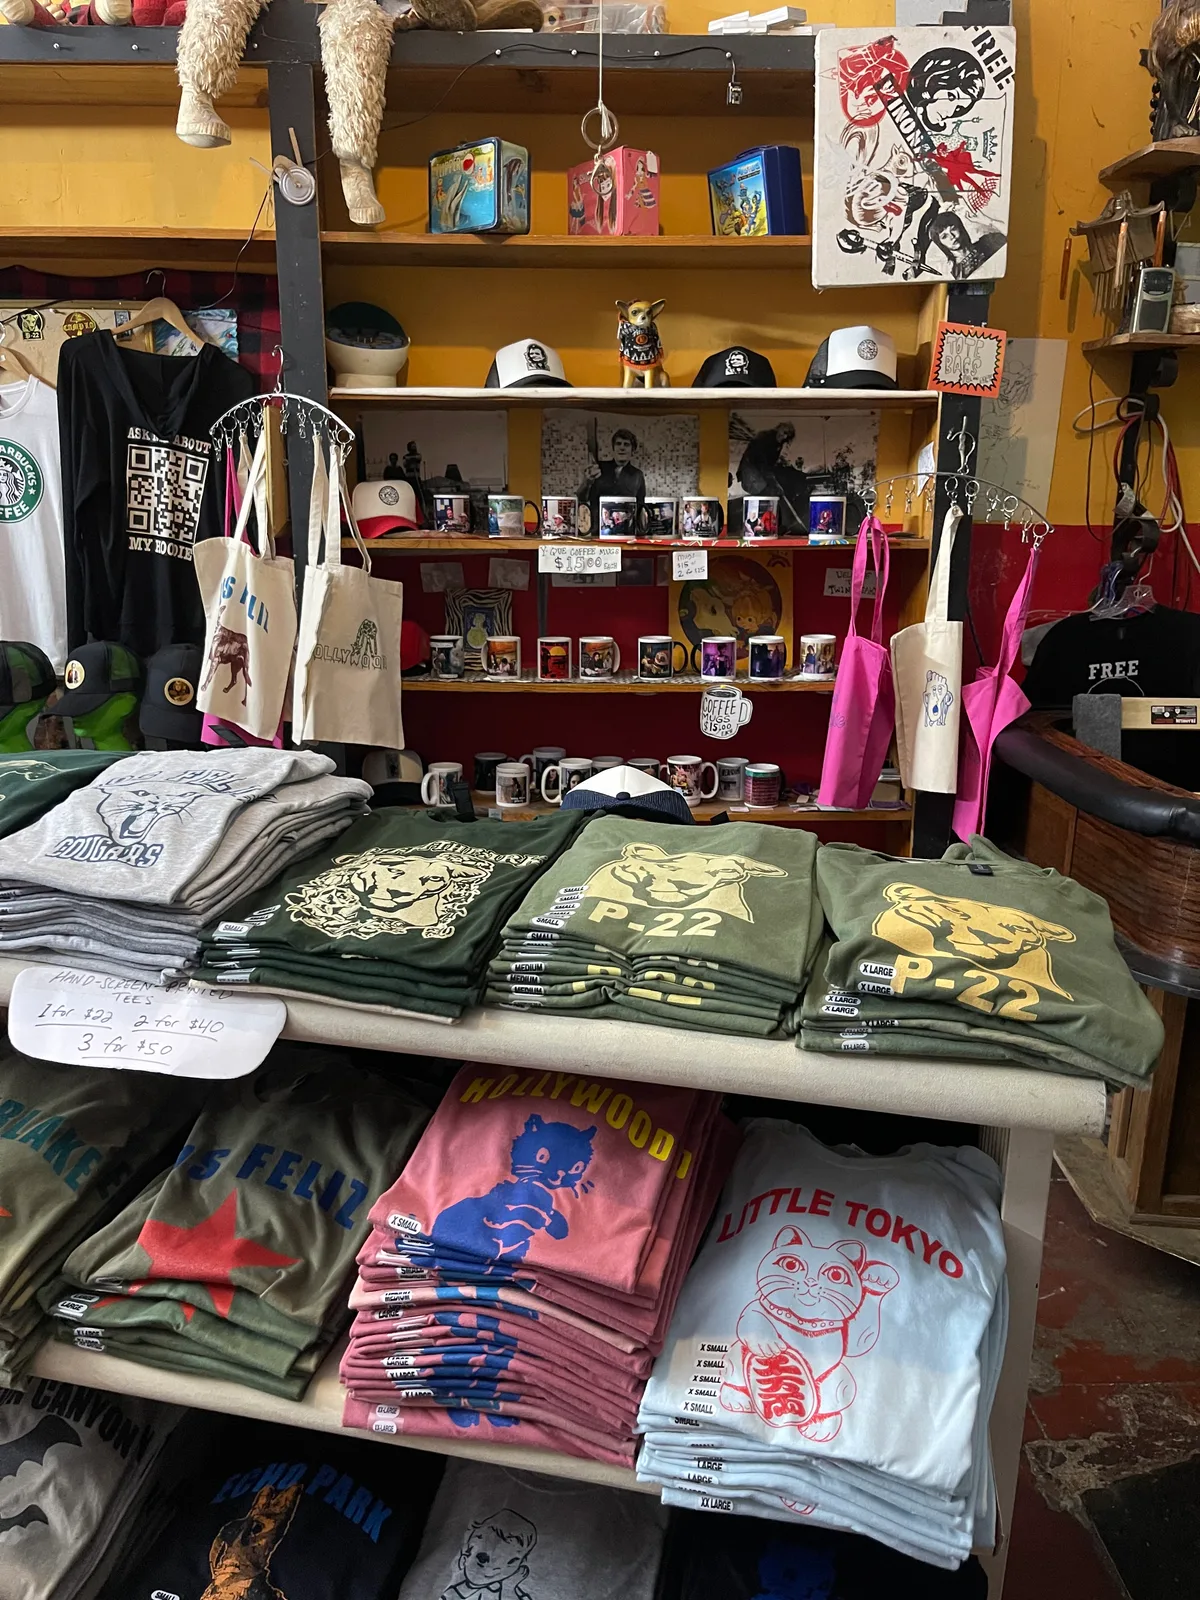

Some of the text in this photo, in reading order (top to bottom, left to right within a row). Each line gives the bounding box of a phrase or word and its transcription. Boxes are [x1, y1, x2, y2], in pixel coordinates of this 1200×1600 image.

[946, 336, 984, 359] TOTE
[945, 355, 982, 376] BAGS
[127, 427, 150, 441] ASK
[173, 434, 212, 454] ABOUT
[129, 537, 193, 561] MY HOODIE
[570, 548, 596, 556] COFFEE
[1088, 660, 1139, 680] FREE
[703, 697, 737, 716] COFFEE
[702, 713, 731, 724] MUGS
[45, 834, 164, 868] COUGARS
[536, 917, 560, 926] SMALL
[588, 900, 722, 937] P-22
[514, 963, 543, 972] MEDIUM
[862, 964, 894, 977] X LARGE
[509, 975, 538, 983] MEDIUM
[860, 983, 866, 991] X
[867, 985, 891, 996] LARGE
[890, 954, 1040, 1022] P-22
[112, 991, 154, 1005] TEES
[834, 996, 859, 1004] LARGE
[831, 1006, 855, 1014] LARGE
[52, 1006, 74, 1018] for
[84, 1009, 113, 1022] $22
[133, 1015, 148, 1028] 2
[155, 1017, 180, 1028] for
[189, 1020, 225, 1033] $40
[77, 1033, 172, 1055] 3 for $50
[459, 1073, 675, 1162] HOLLYWOOD
[236, 1143, 369, 1230] FELIZ
[391, 1216, 418, 1232] X SMALL
[716, 1187, 964, 1279] LITTLE TOKYO
[61, 1301, 83, 1311] LARGE
[700, 1343, 706, 1351] X
[697, 1359, 725, 1368] X SMALL
[683, 1402, 713, 1414] X SMALL
[32, 1379, 139, 1458] CANYON
[674, 1417, 700, 1427] SMALL
[697, 1461, 722, 1471] LARGE
[304, 1463, 392, 1544] PARK
[710, 1499, 731, 1510] LARGE
